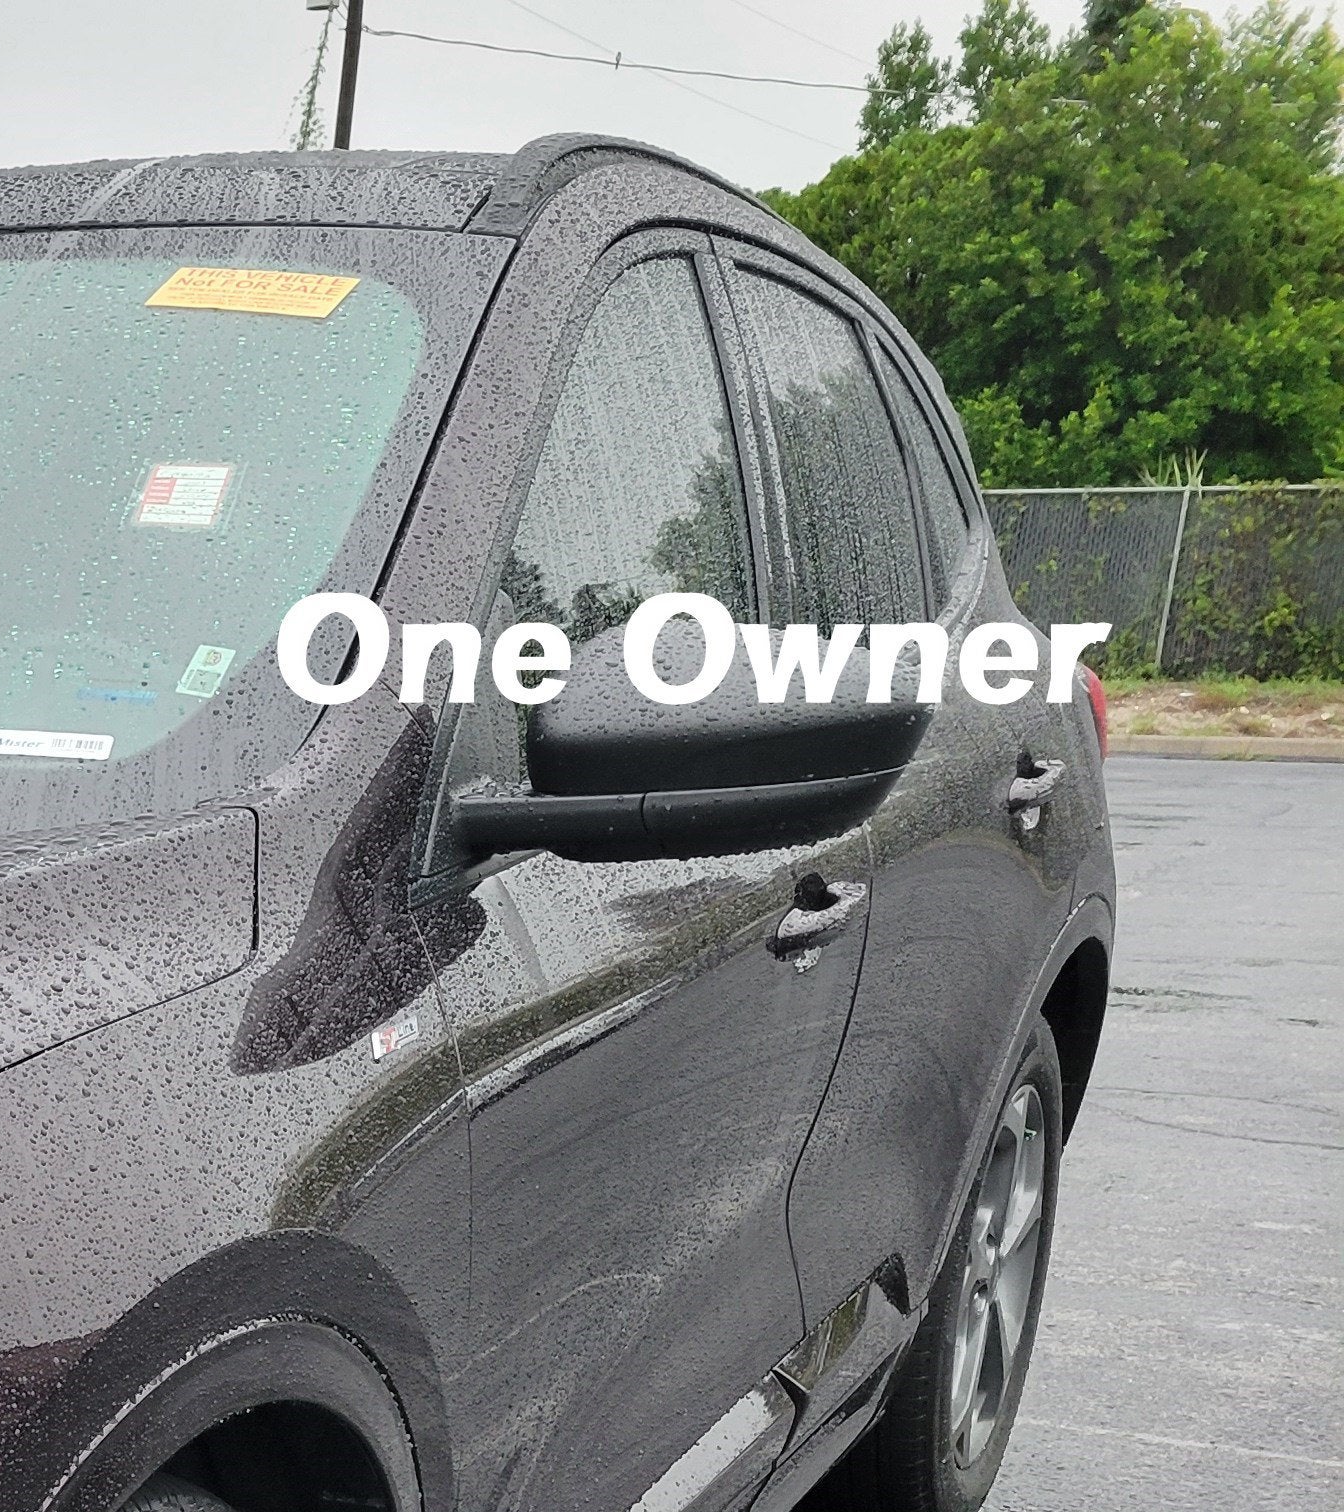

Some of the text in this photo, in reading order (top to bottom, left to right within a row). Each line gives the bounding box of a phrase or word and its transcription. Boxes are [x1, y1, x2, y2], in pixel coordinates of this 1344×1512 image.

[175, 277, 215, 287] Not
[221, 279, 272, 291] FOR
[277, 283, 342, 297] SALE
[187, 268, 347, 287] THIS VEHICLE
